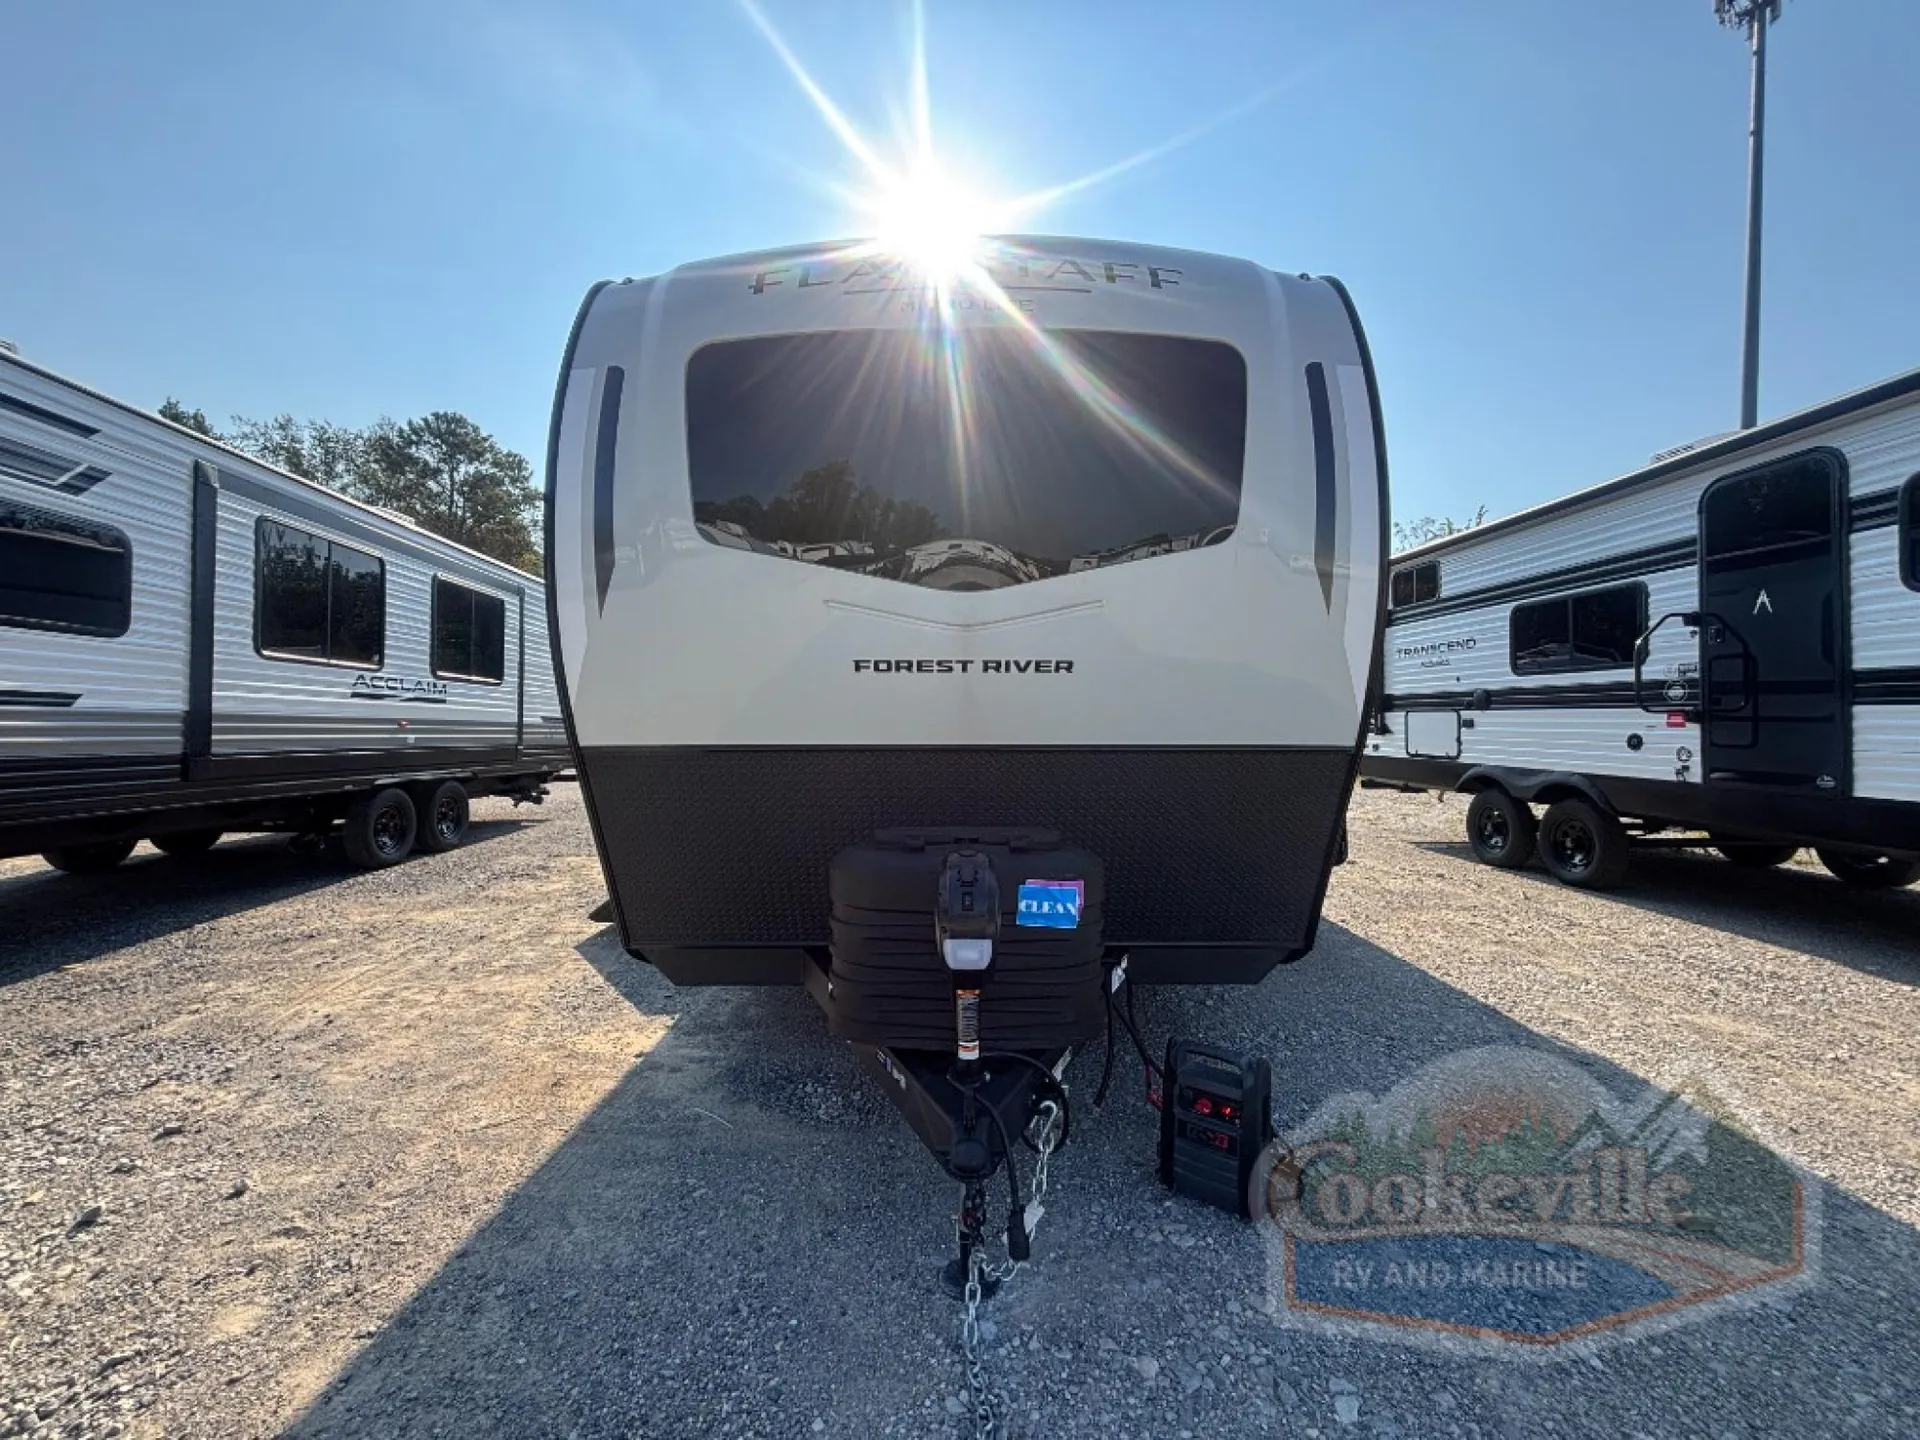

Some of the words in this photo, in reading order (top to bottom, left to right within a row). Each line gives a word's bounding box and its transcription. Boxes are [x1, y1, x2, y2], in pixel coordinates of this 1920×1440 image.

[747, 258, 1184, 295] FLATAFF
[1397, 638, 1476, 658] TRANSCEND
[852, 659, 974, 673] FOREST
[982, 659, 1074, 673] RIVER
[352, 674, 447, 695] ACCLAIM
[1019, 899, 1076, 916] CLEAN
